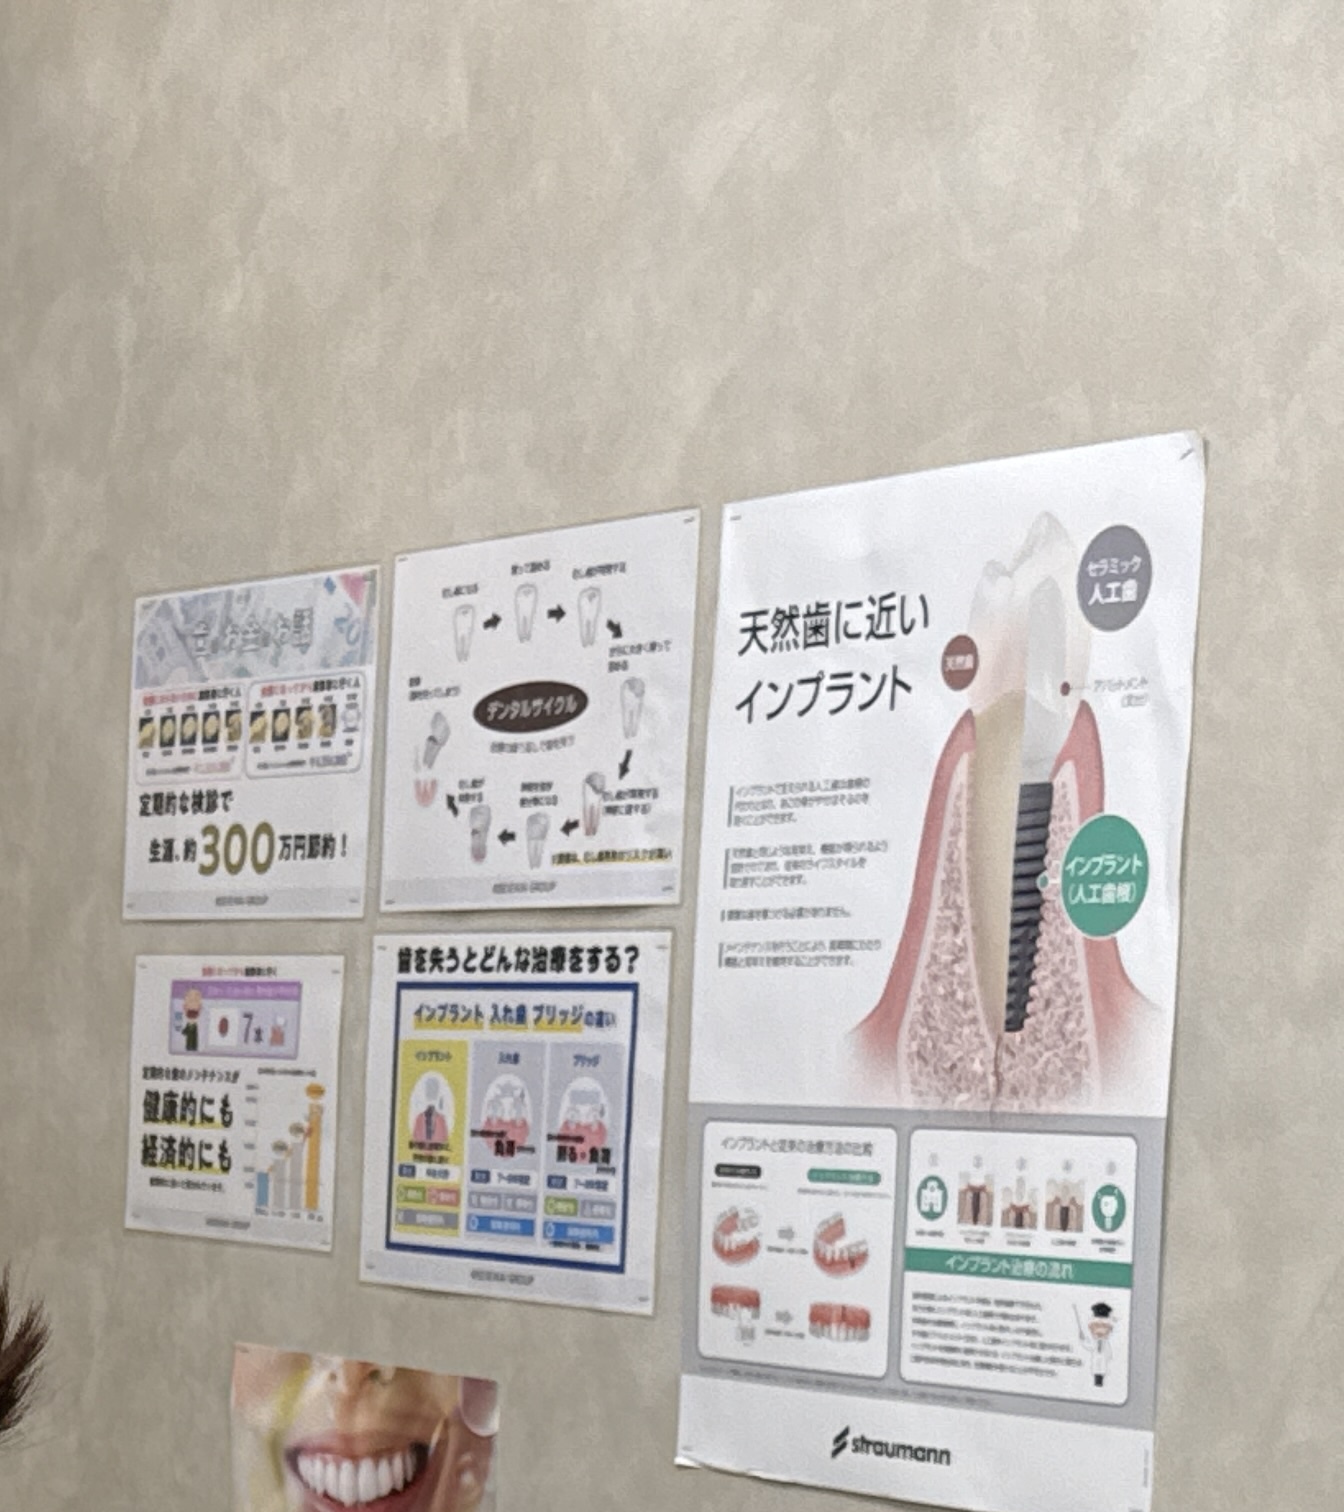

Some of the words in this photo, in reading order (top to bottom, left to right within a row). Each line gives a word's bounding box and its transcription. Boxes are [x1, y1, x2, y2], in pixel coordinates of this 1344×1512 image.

[1086, 554, 1142, 577] セラミック
[1087, 579, 1139, 606] 人工歯
[738, 591, 932, 658] 天然歯に近い
[945, 653, 975, 671] 天然歯
[484, 693, 579, 722] デンタルサイクル
[735, 664, 913, 724] インプラント
[1064, 853, 1144, 882] インプラント
[1067, 880, 1138, 906] (人工歯根)
[397, 944, 640, 974] 歯を失うとどんな治療をする?
[413, 1002, 485, 1023] インプラント
[142, 1088, 234, 1128] 健康的にも
[140, 1131, 232, 1172] 経済的にも
[850, 1433, 952, 1467] straumann
